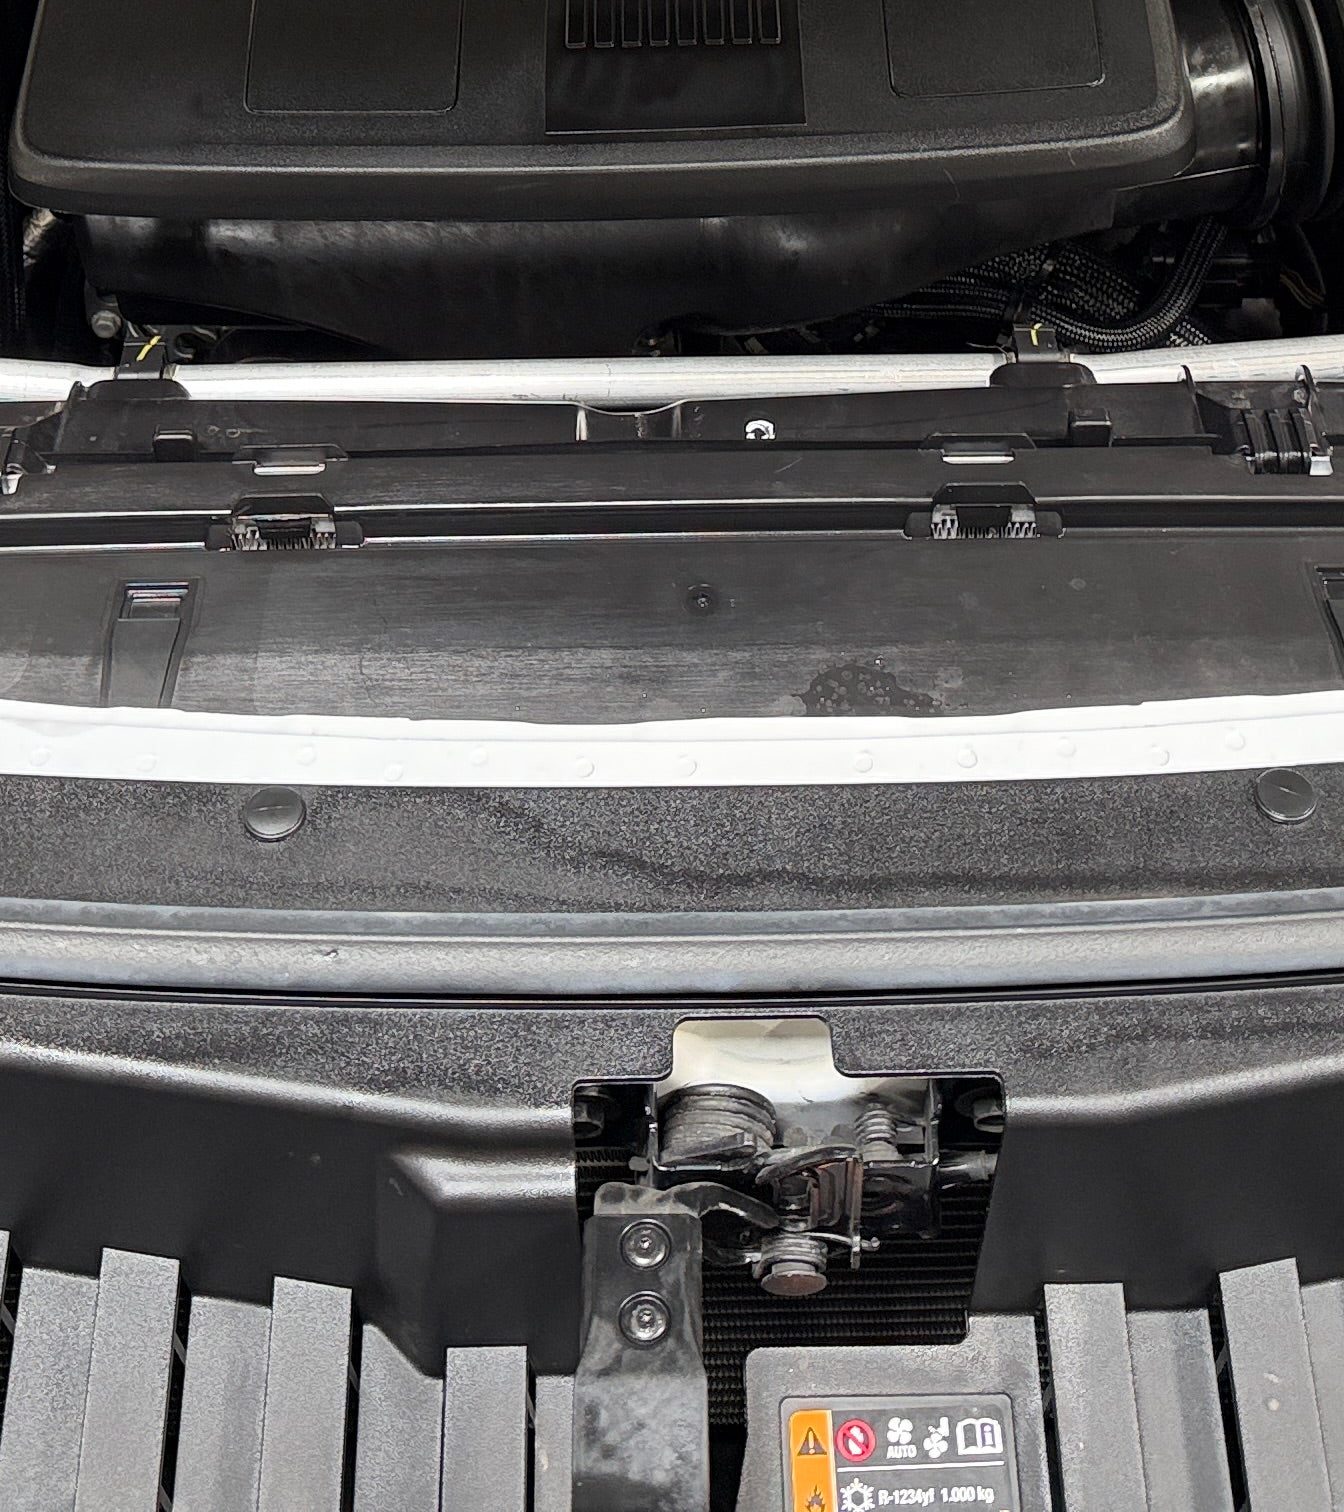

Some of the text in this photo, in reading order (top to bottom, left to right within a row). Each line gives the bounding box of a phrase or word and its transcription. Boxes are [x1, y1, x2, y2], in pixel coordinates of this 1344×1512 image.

[886, 1444, 917, 1459] AUTO
[878, 1485, 995, 1507] R-1234yf 1.000 kg
